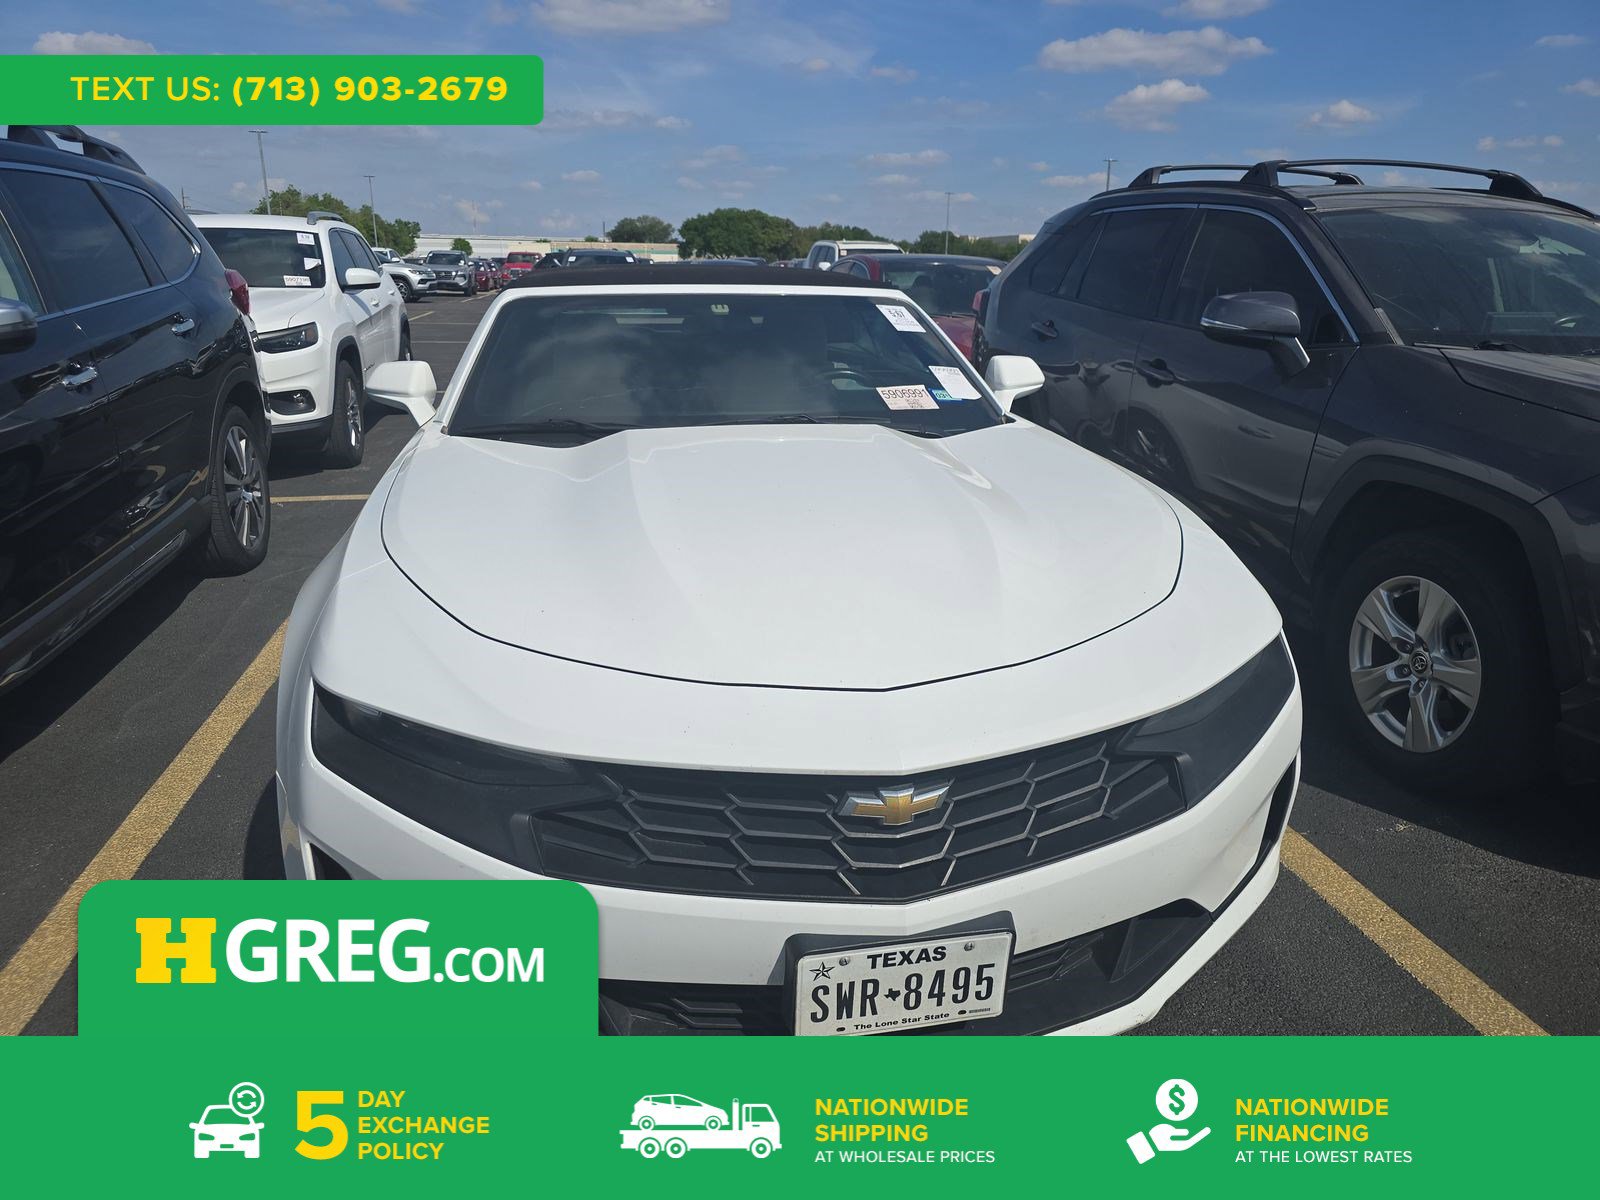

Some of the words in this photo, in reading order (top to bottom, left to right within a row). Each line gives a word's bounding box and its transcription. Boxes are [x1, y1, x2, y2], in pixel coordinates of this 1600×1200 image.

[881, 388, 929, 399] 5906991
[867, 946, 947, 969] TEXAS
[810, 978, 880, 1023] SWR
[903, 963, 996, 1011] 8495
[875, 1019, 899, 1028] Lone
[901, 1015, 922, 1024] Star
[924, 1012, 950, 1021] State
